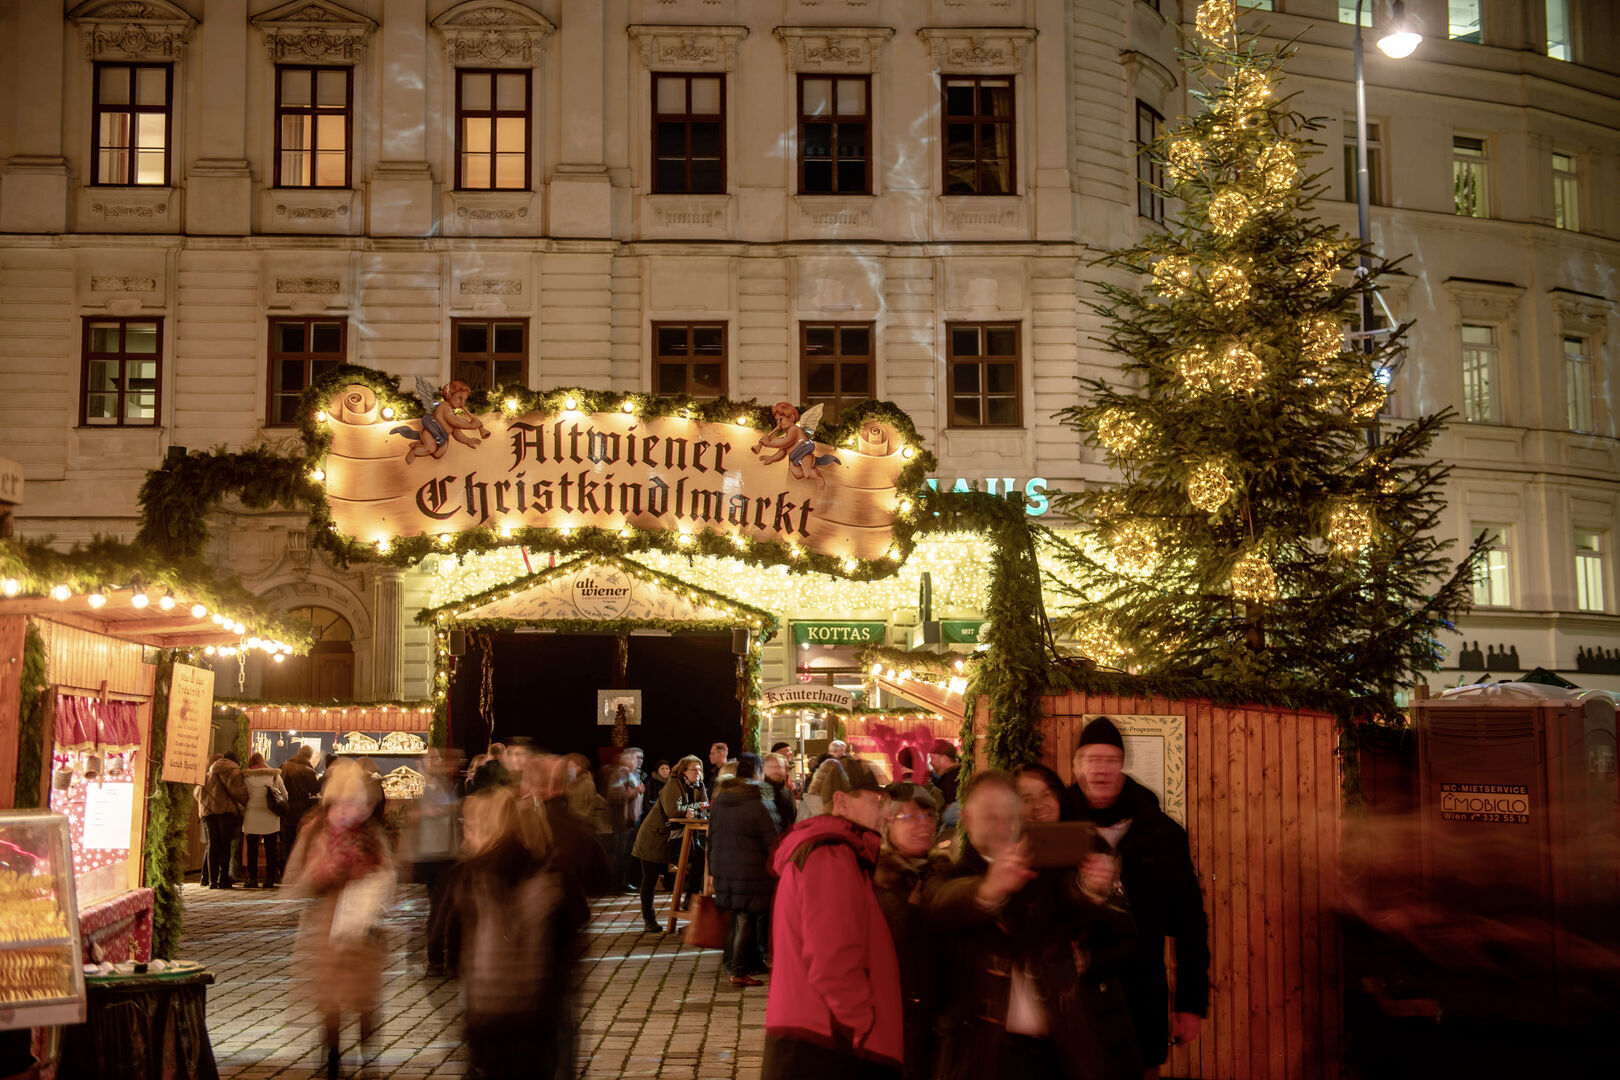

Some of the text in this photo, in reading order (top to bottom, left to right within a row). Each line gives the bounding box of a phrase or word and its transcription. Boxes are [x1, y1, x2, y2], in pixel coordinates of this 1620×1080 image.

[507, 419, 732, 475] Altwiener
[415, 469, 815, 538] Christkindlmarkt
[581, 588, 629, 596] wiener
[807, 626, 871, 641] KOTTAS
[763, 688, 849, 705] Kräuterhaus
[1443, 784, 1526, 794] WC-MIETSERVICE
[1455, 798, 1526, 813] MOBICLO
[1443, 813, 1467, 821] Wien
[1482, 814, 1500, 822] 332
